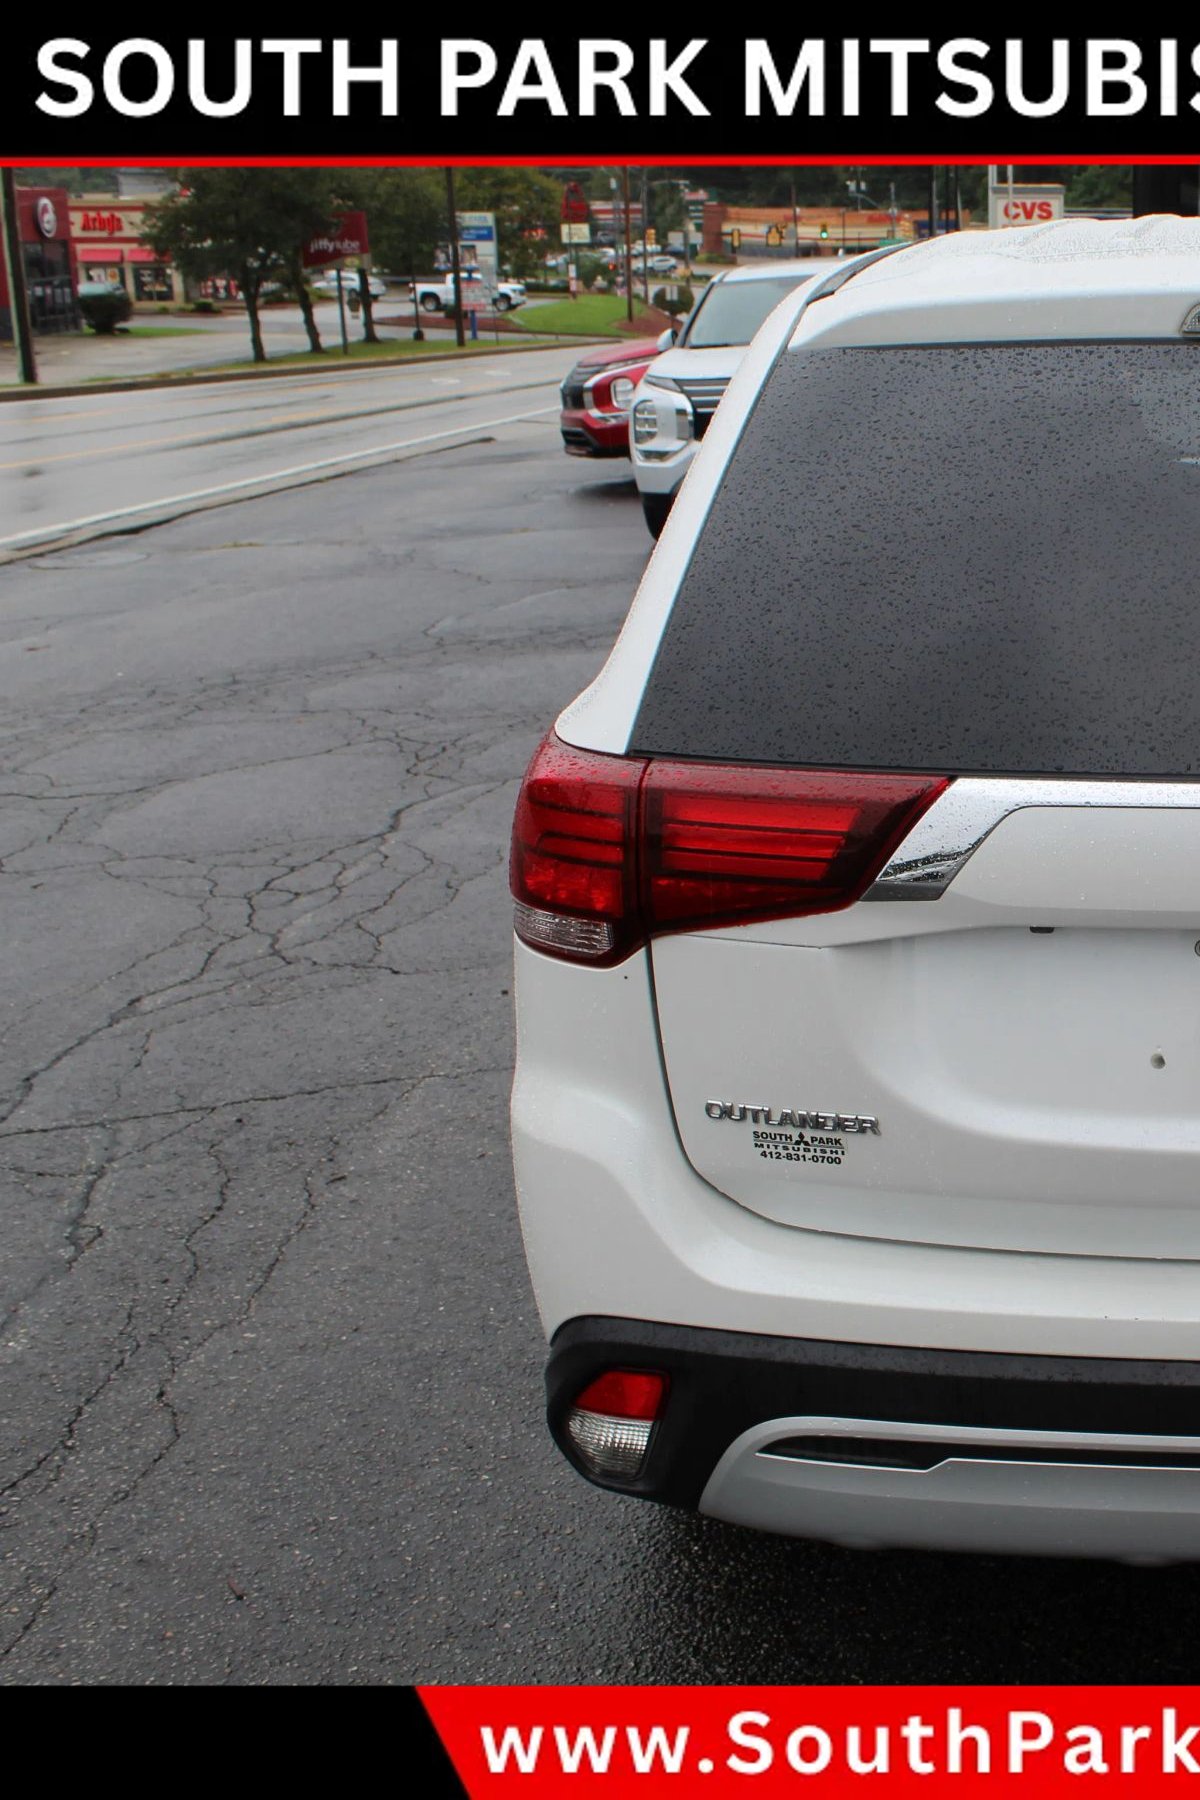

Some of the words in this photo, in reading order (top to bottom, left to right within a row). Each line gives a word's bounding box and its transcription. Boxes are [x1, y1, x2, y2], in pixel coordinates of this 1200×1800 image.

[1004, 201, 1053, 220] CVS
[705, 1100, 882, 1136] OUTLANDER
[752, 1130, 793, 1142] SOUTH
[810, 1135, 842, 1147] PARK
[753, 1142, 846, 1156] MITSUBISHI
[760, 1150, 842, 1166] 412-831-0700
